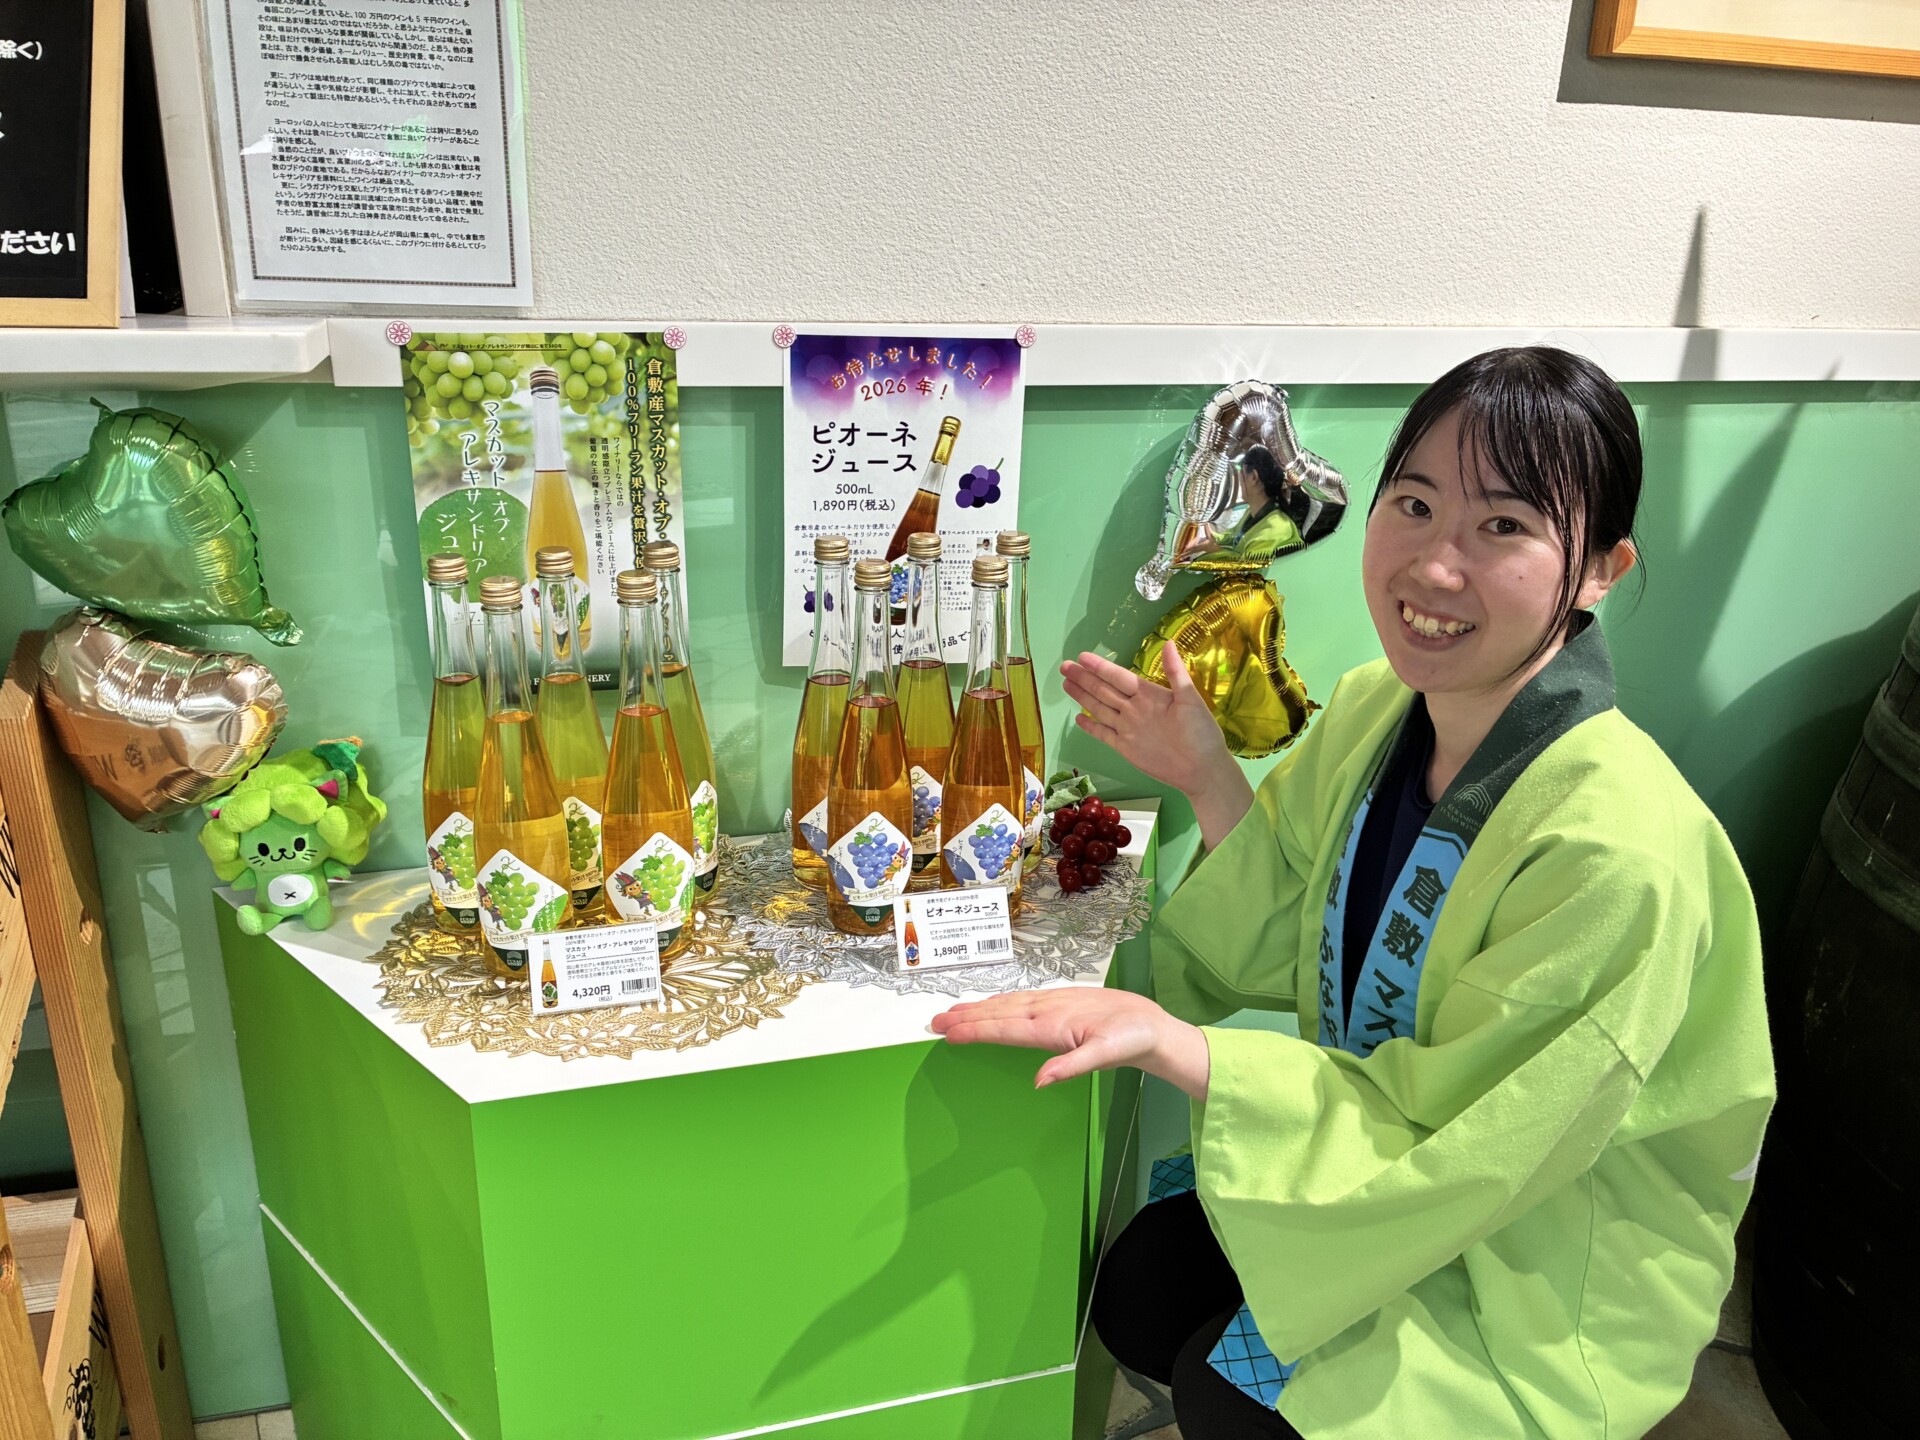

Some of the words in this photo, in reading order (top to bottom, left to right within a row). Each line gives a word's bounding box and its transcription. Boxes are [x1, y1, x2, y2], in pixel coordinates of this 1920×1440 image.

[812, 421, 917, 447] ピオーネ
[812, 449, 917, 473] ジュース
[613, 437, 625, 507] ワイナリーならではの
[835, 484, 874, 495] 500mL
[460, 433, 488, 573] アレキサンドリア
[926, 902, 1000, 918] ピオーネジュース
[565, 938, 655, 953] マスカット・オブ・アレキサンドリア
[933, 944, 967, 957] 1,890円
[565, 952, 587, 960] ジュース
[572, 984, 611, 999] 4,320円
